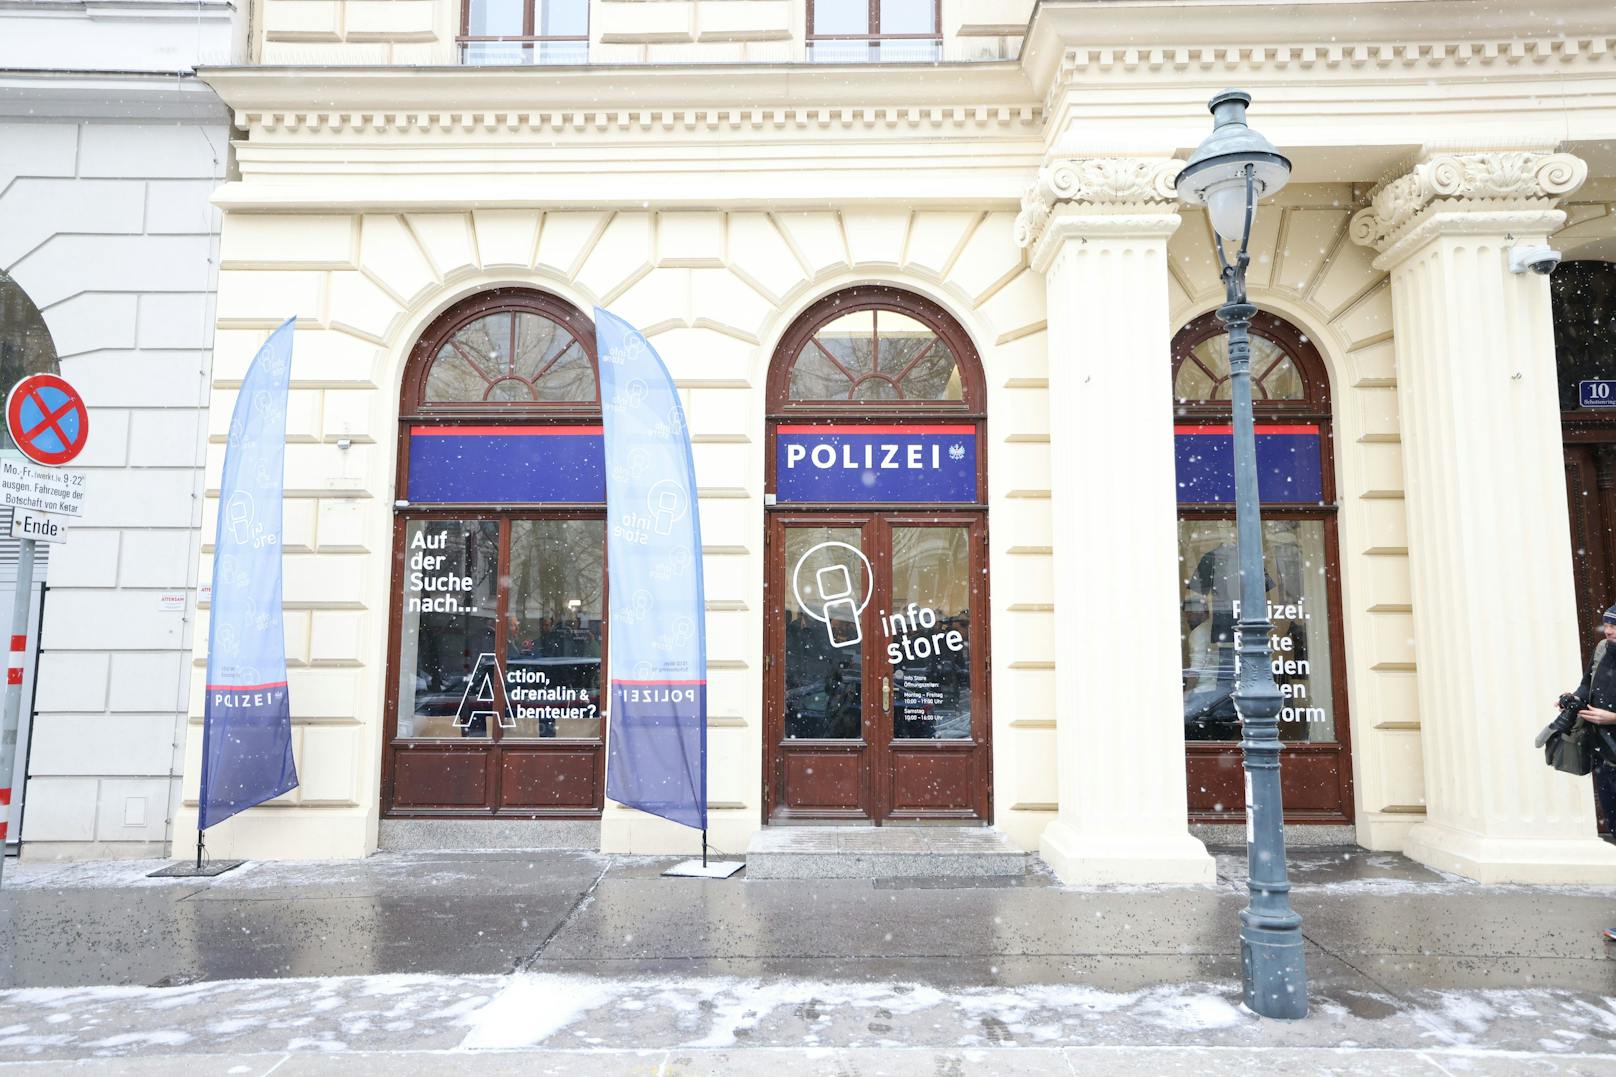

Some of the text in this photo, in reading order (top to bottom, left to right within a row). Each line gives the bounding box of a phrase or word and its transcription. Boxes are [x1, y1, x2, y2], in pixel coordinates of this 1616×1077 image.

[1589, 383, 1610, 398] 10
[787, 444, 940, 469] POLIZEI
[2, 480, 84, 499] ausgen. Fahrzeuge der
[5, 493, 43, 508] Botschaft
[44, 500, 58, 510] von
[24, 516, 58, 536] Ende
[410, 530, 448, 549] Auf
[410, 551, 447, 570] der
[409, 572, 473, 591] Suche
[408, 593, 478, 612] nach...
[1232, 600, 1311, 619] Pizei.
[880, 602, 936, 638] info
[886, 630, 964, 664] store
[1233, 631, 1293, 652] Bte
[506, 668, 550, 686] ction,
[452, 652, 517, 728] A
[511, 686, 590, 701] drenalin &
[903, 691, 922, 699] Montag
[516, 703, 596, 719] benteuer?
